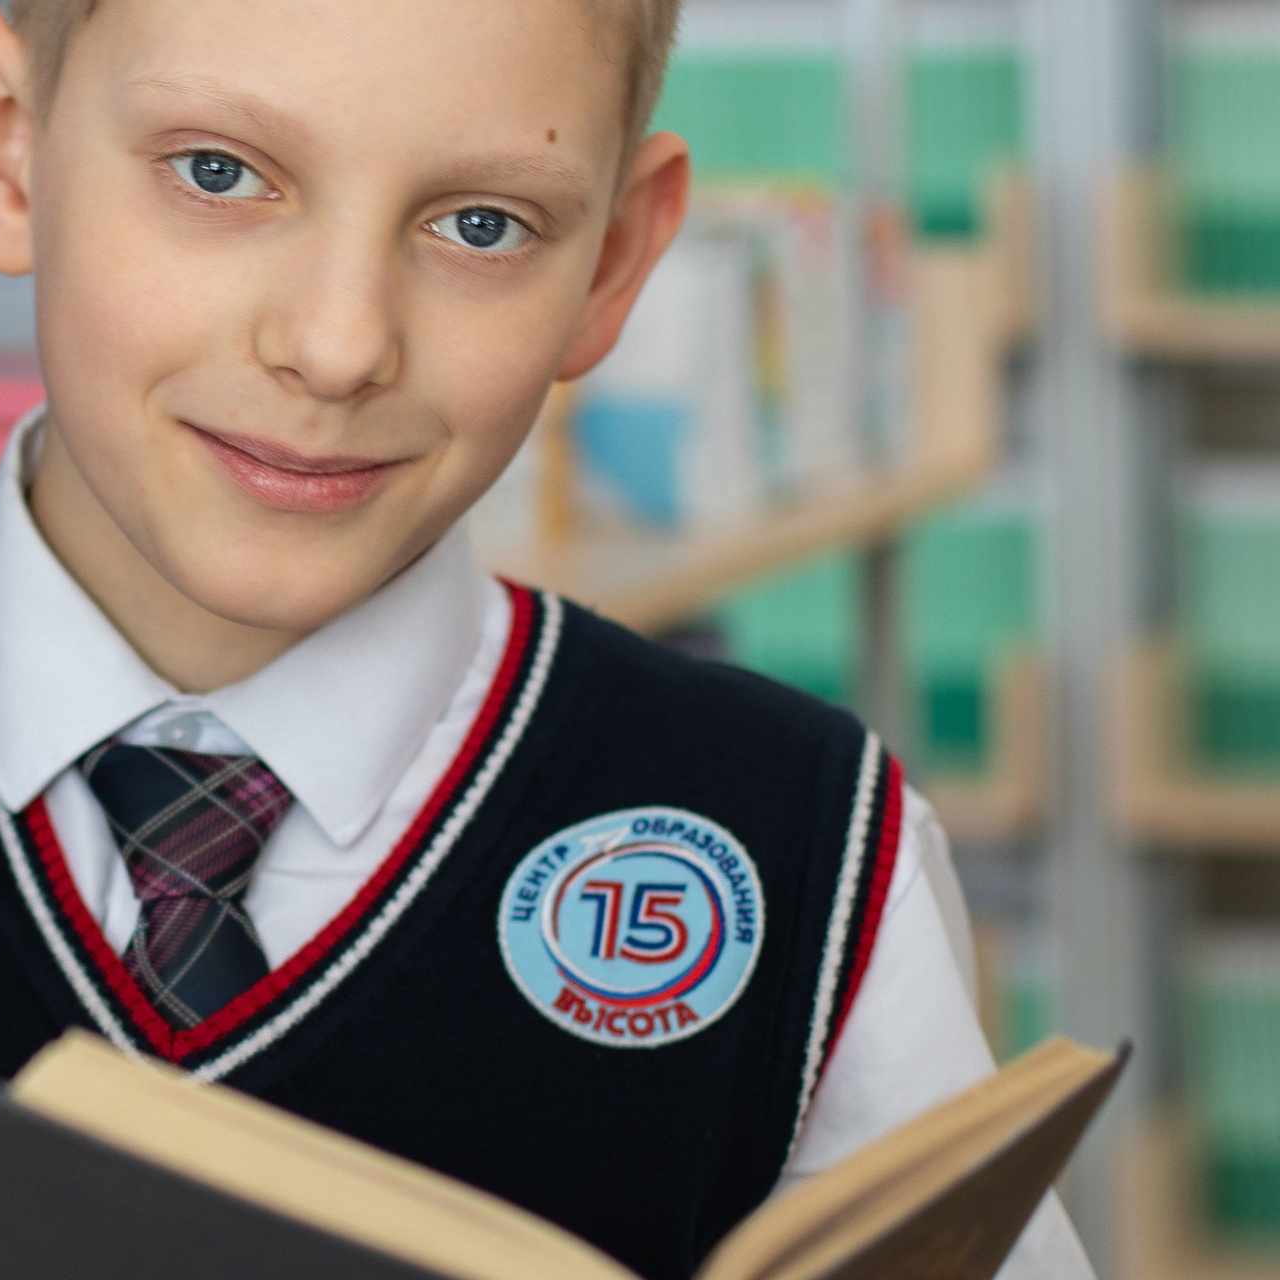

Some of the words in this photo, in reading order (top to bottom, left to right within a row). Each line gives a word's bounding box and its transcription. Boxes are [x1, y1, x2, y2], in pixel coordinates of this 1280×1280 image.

[511, 844, 570, 923] ЦЕНТР
[631, 817, 755, 944] ОБРАЗОВАНИЯ
[579, 879, 689, 965] 15
[552, 985, 701, 1038] ВЫСОТА
